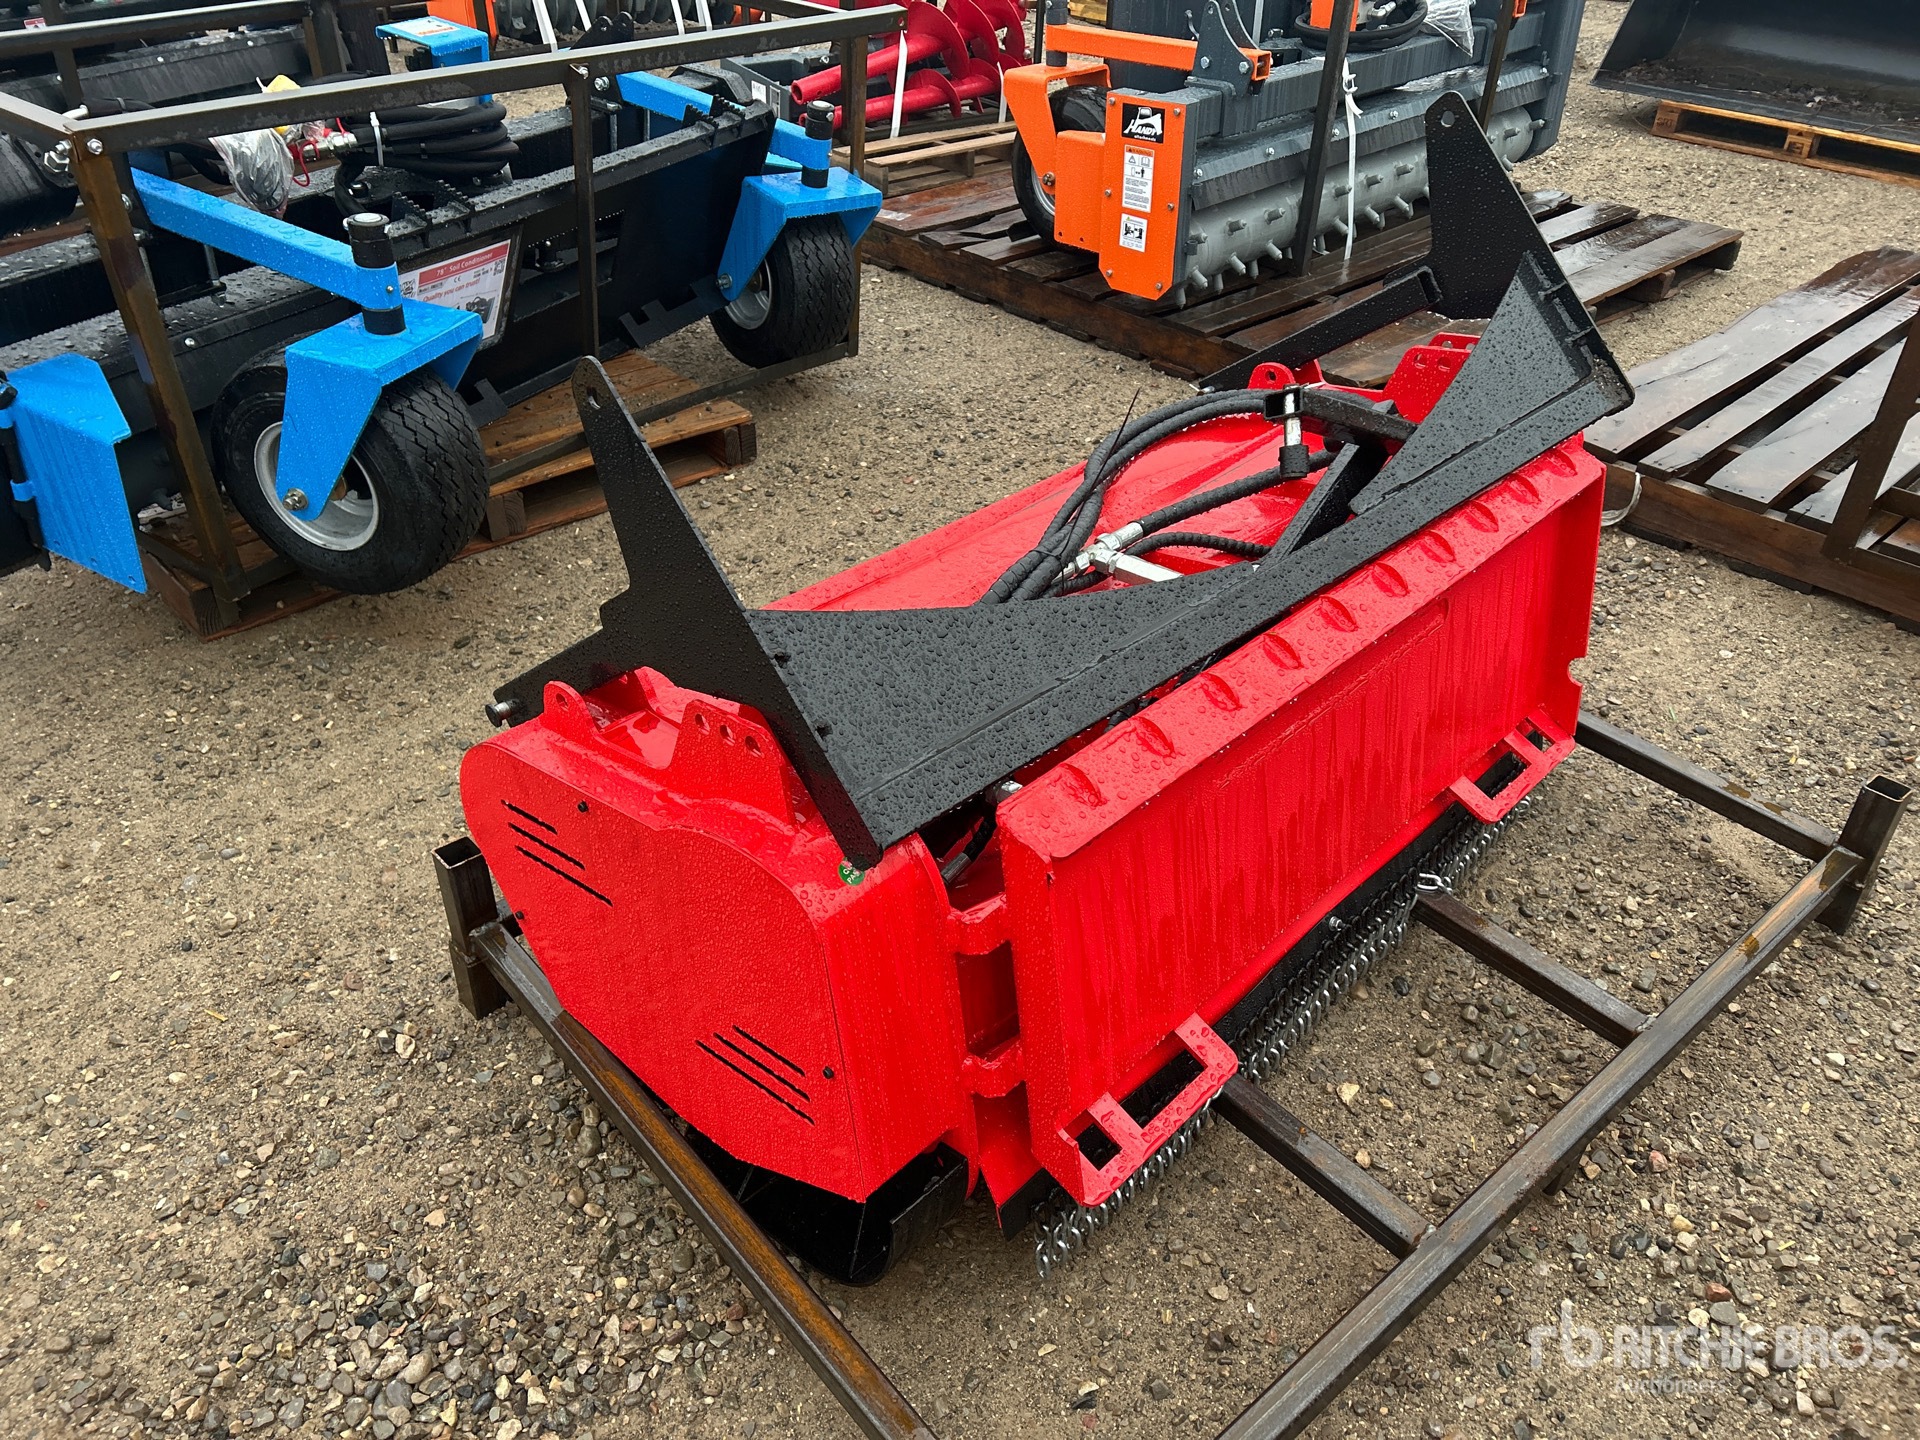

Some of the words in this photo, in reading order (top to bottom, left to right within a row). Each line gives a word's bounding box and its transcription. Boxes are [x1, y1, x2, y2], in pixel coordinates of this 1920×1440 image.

[1123, 119, 1157, 136] HANDY
[449, 263, 460, 272] Soil
[461, 253, 493, 268] Conditioner
[423, 291, 443, 302] Quality
[443, 287, 454, 296] you
[455, 284, 465, 292] can
[466, 278, 480, 288] trust!
